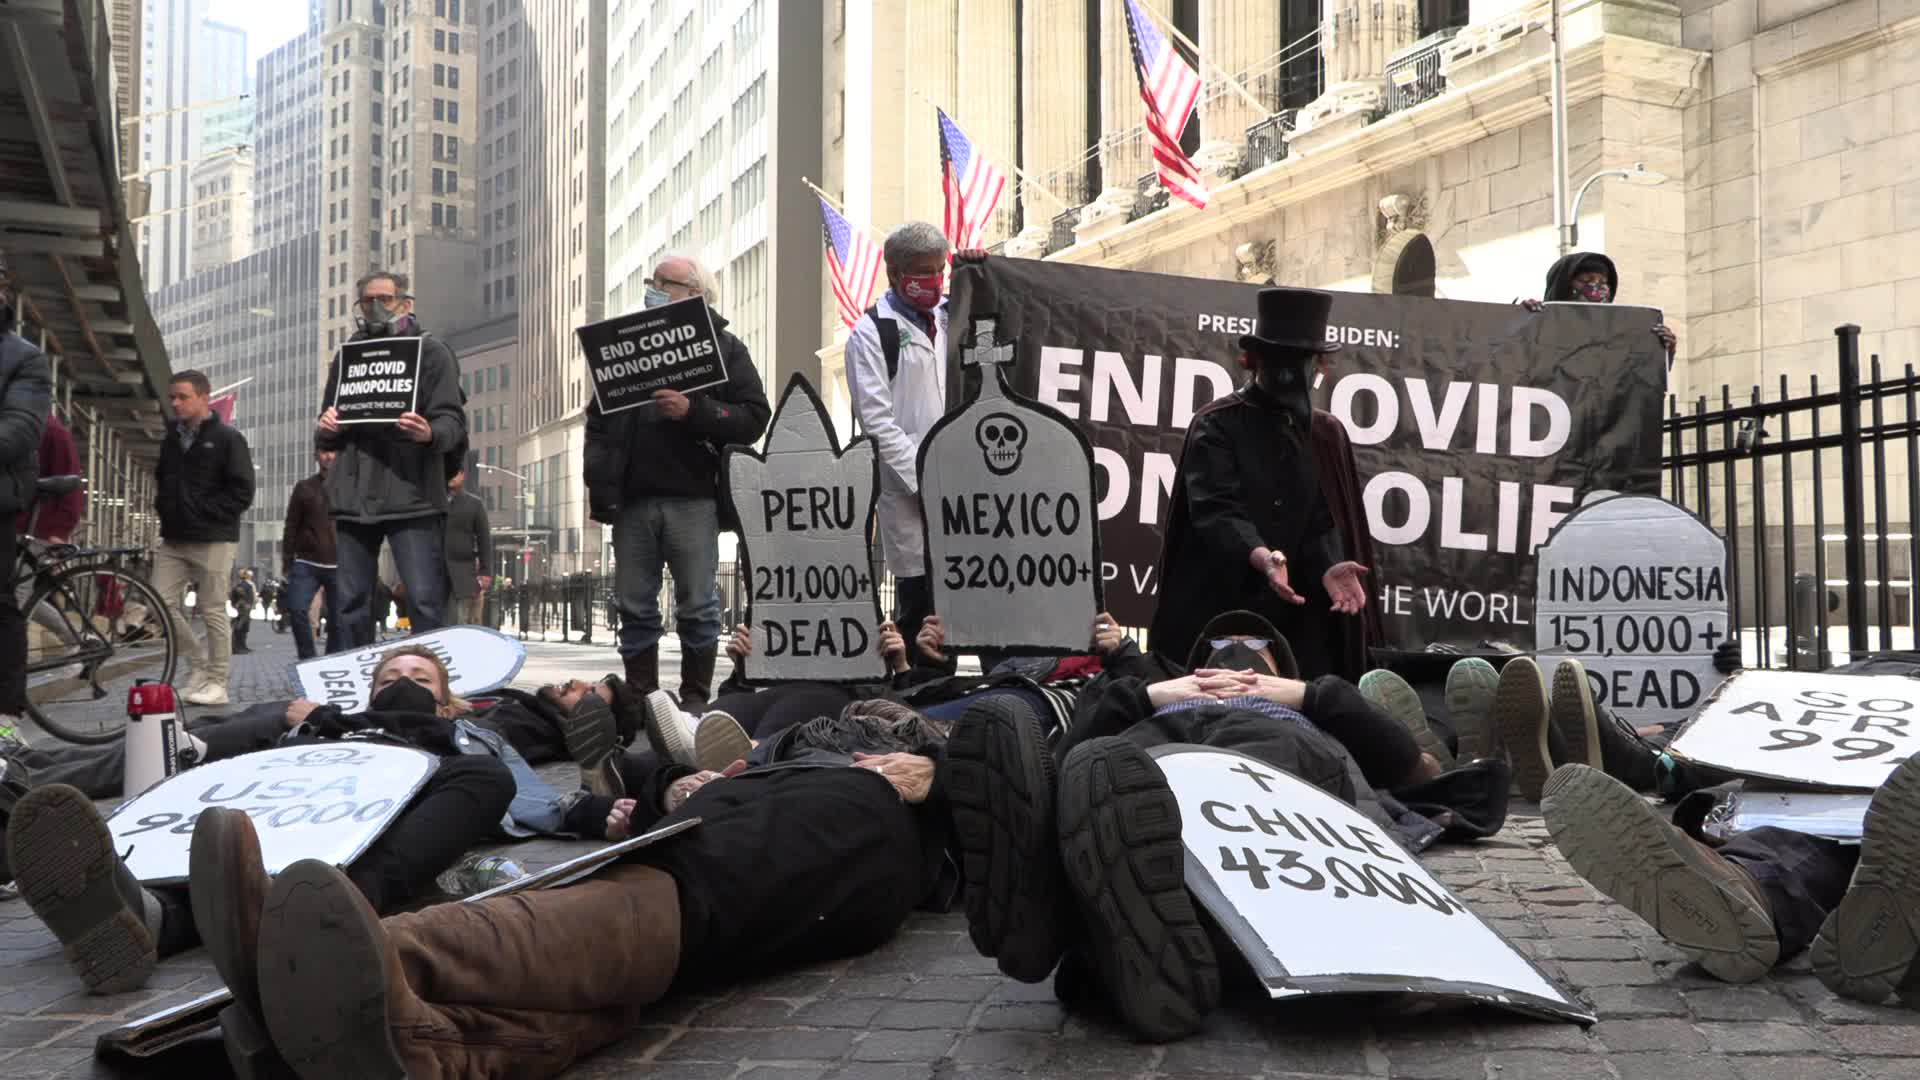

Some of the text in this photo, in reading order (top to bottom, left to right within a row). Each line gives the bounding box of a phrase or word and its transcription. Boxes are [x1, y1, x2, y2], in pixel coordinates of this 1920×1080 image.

[600, 324, 696, 361] END COVID
[1198, 313, 1400, 349] PRESI BIDEN:
[348, 360, 406, 378] END COVID
[595, 339, 714, 383] MONOPOLIES
[668, 372, 683, 383] THE
[684, 364, 713, 378] WORLD
[340, 379, 413, 396] MONOPOLIES
[1038, 345, 1571, 458] END OVID
[761, 486, 855, 532] PERU
[942, 491, 1080, 538] MEXICO
[755, 564, 870, 602] 211,000+
[943, 552, 1092, 593] 320,000+
[1549, 565, 1724, 603] INDONESIA
[1424, 587, 1530, 626] WORL
[762, 617, 868, 658] DEAD
[1550, 614, 1722, 657] 151,000+
[319, 669, 359, 714] DEAD
[1728, 700, 1911, 737] AFR
[198, 775, 358, 803] USA
[1200, 800, 1404, 864] CHILE
